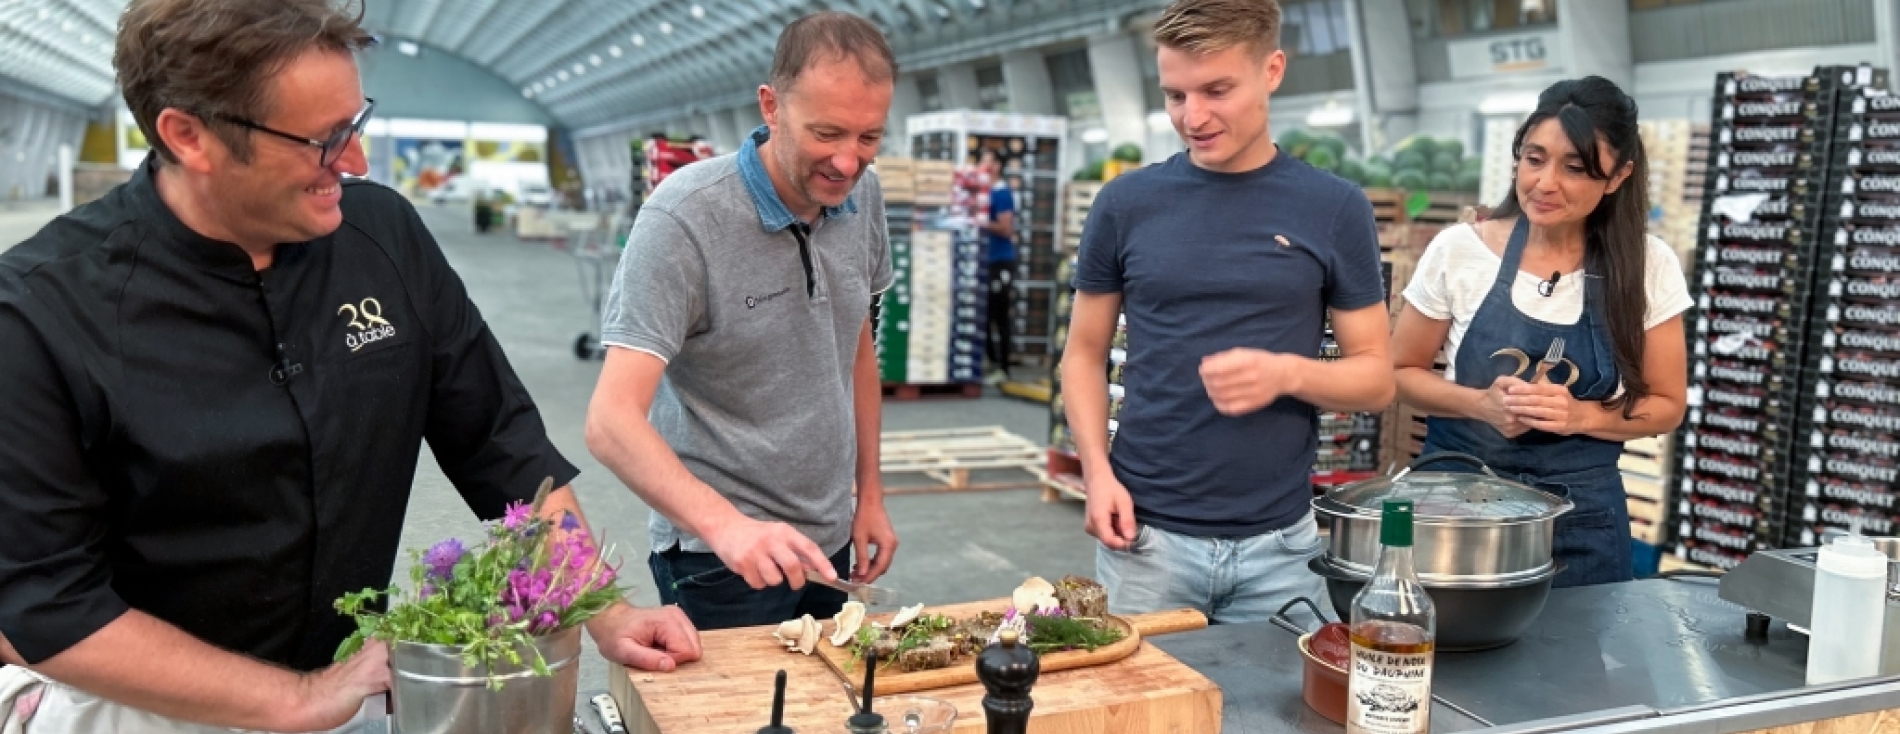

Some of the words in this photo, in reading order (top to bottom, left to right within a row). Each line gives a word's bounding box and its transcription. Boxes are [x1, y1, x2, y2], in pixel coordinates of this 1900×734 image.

[1489, 37, 1547, 63] STG
[1738, 101, 1799, 116] CONQUET
[1735, 126, 1797, 142] CONQUET
[1733, 151, 1795, 166] CONQUET
[1732, 178, 1788, 191] CONQUET
[1724, 225, 1784, 240] CONQUET
[1721, 249, 1781, 264] CONQUET
[1718, 272, 1779, 288] CONQUET
[1715, 297, 1774, 312] CONQUET
[1712, 319, 1772, 336] CONQUET
[1711, 367, 1763, 384] CONQUET
[1708, 390, 1761, 407] CONQUET
[1706, 413, 1758, 431] CONQUET
[1701, 434, 1759, 456] CONQUET
[1829, 434, 1900, 457] CONQUET
[1698, 458, 1759, 480] CONQUET
[1826, 458, 1897, 482] CONQUET
[1697, 482, 1756, 504] CONQUET
[1824, 483, 1894, 508] CONQUET
[1694, 504, 1753, 527] CONQUET
[1696, 528, 1747, 550] CONQUET
[1356, 661, 1368, 672] DU
[1387, 656, 1401, 666] DE
